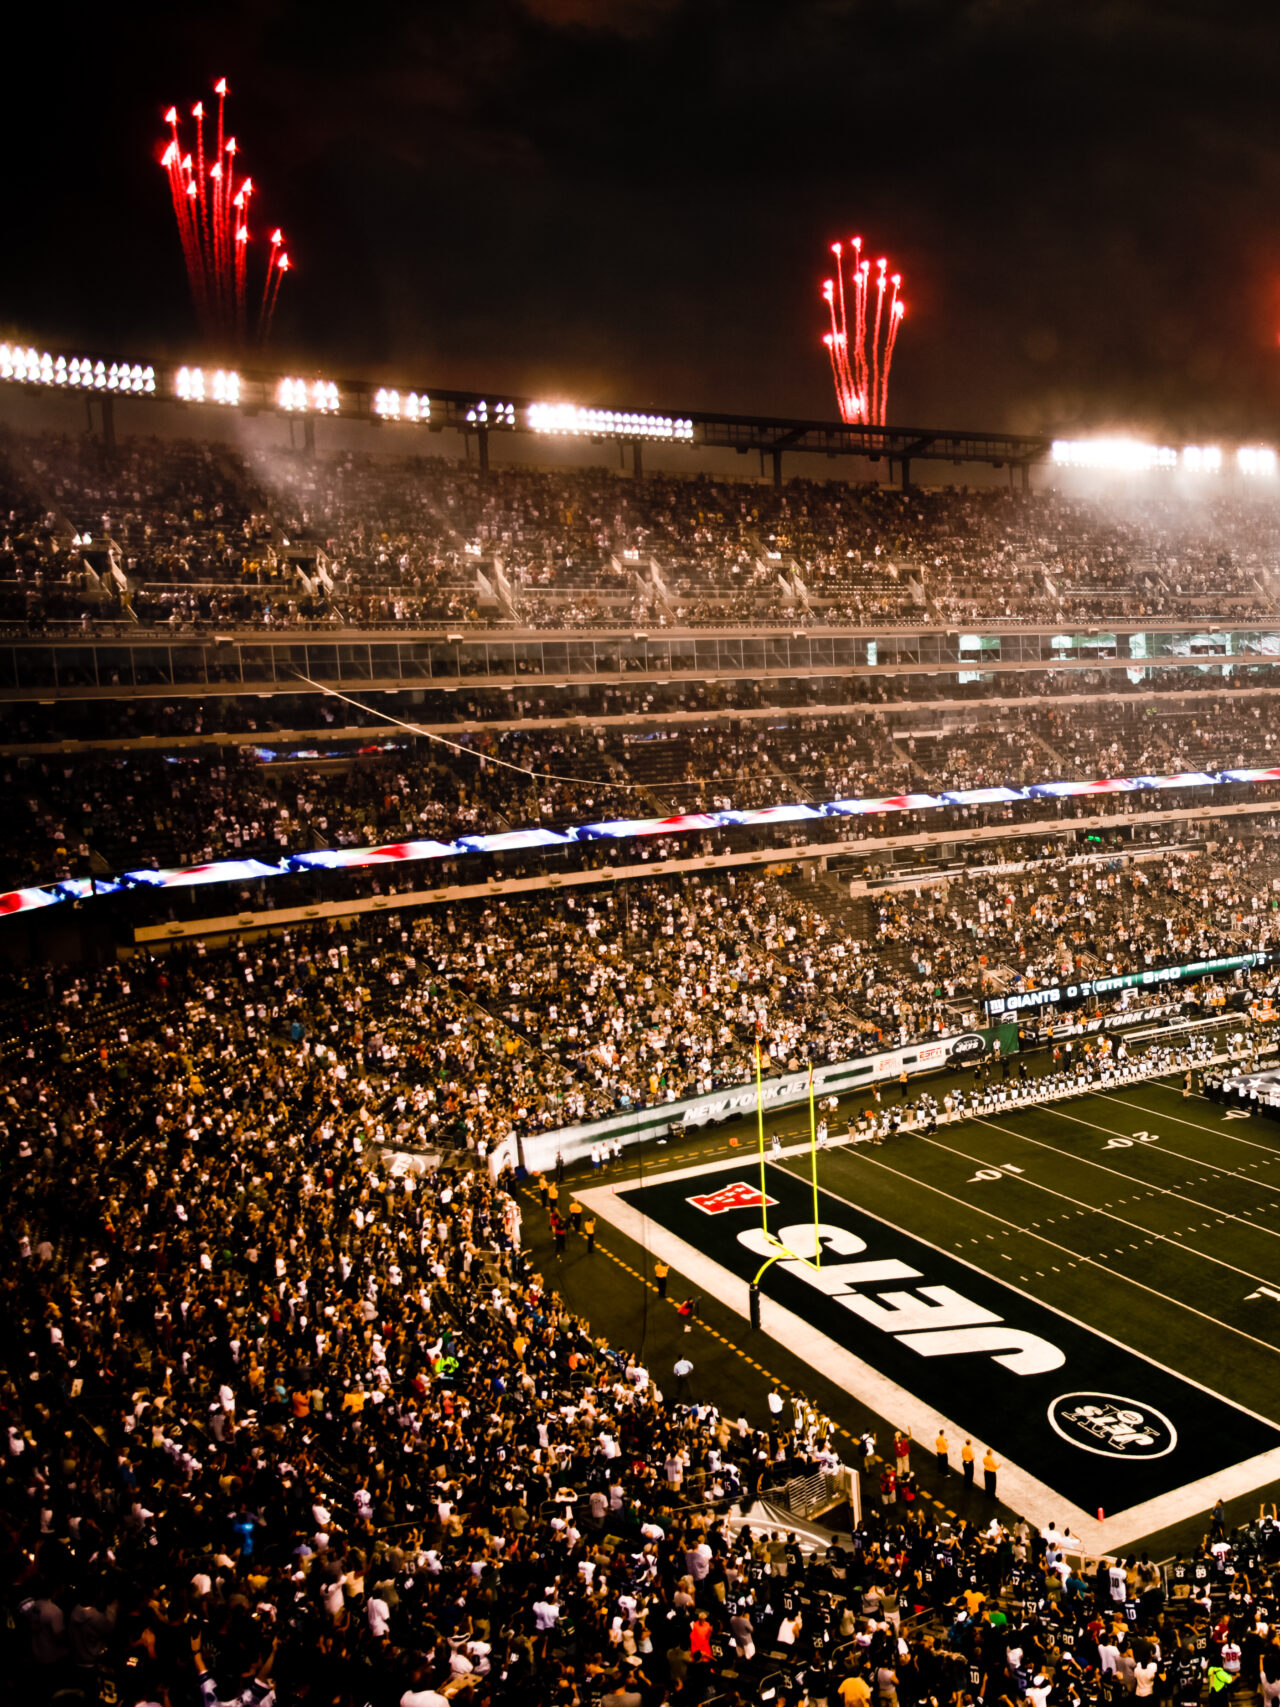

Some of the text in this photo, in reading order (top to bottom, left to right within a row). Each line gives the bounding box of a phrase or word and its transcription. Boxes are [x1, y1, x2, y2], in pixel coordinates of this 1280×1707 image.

[1007, 989, 1061, 1010] GIANTS
[1067, 986, 1078, 998] 0
[1143, 967, 1181, 984] 5:40
[1104, 1011, 1143, 1028] YORK
[919, 1047, 943, 1059] ESPN
[682, 1075, 826, 1121] NEW YORK JETS
[1106, 1131, 1160, 1148] 20
[974, 1163, 1026, 1181] 10
[736, 1223, 1066, 1376] JETS
[784, 1599, 792, 1610] 10
[1126, 1609, 1136, 1620] 10
[970, 1672, 979, 1684] 10
